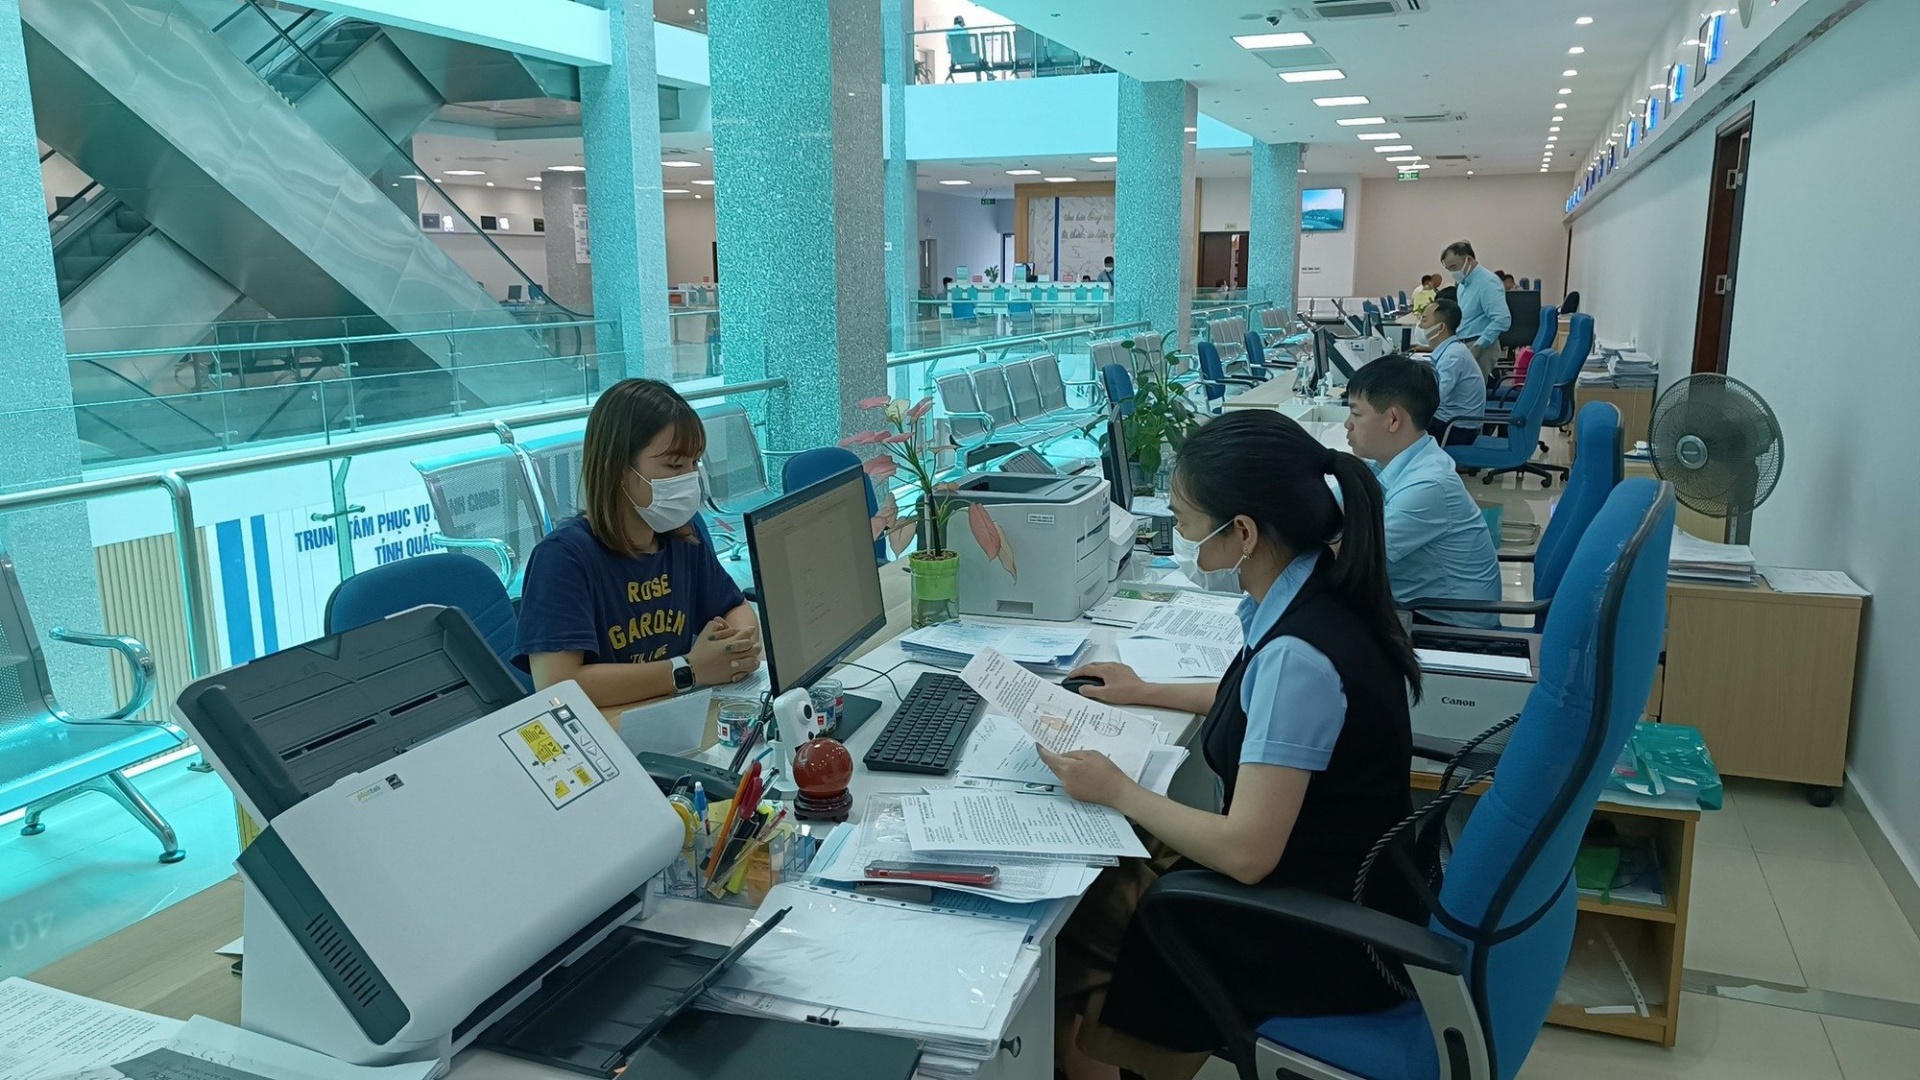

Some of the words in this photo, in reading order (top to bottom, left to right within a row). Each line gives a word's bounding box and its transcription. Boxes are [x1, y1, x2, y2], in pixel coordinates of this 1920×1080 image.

[295, 525, 336, 552] TRUN
[377, 508, 411, 534] PHỤC
[414, 503, 430, 527] VỤ
[374, 538, 404, 565] TỈNH
[406, 528, 444, 558] QUẢN
[627, 574, 672, 603] ROSE
[608, 608, 686, 650] GARDEN
[1441, 696, 1476, 707] Canon
[533, 723, 546, 736] A3
[547, 741, 560, 753] A4
